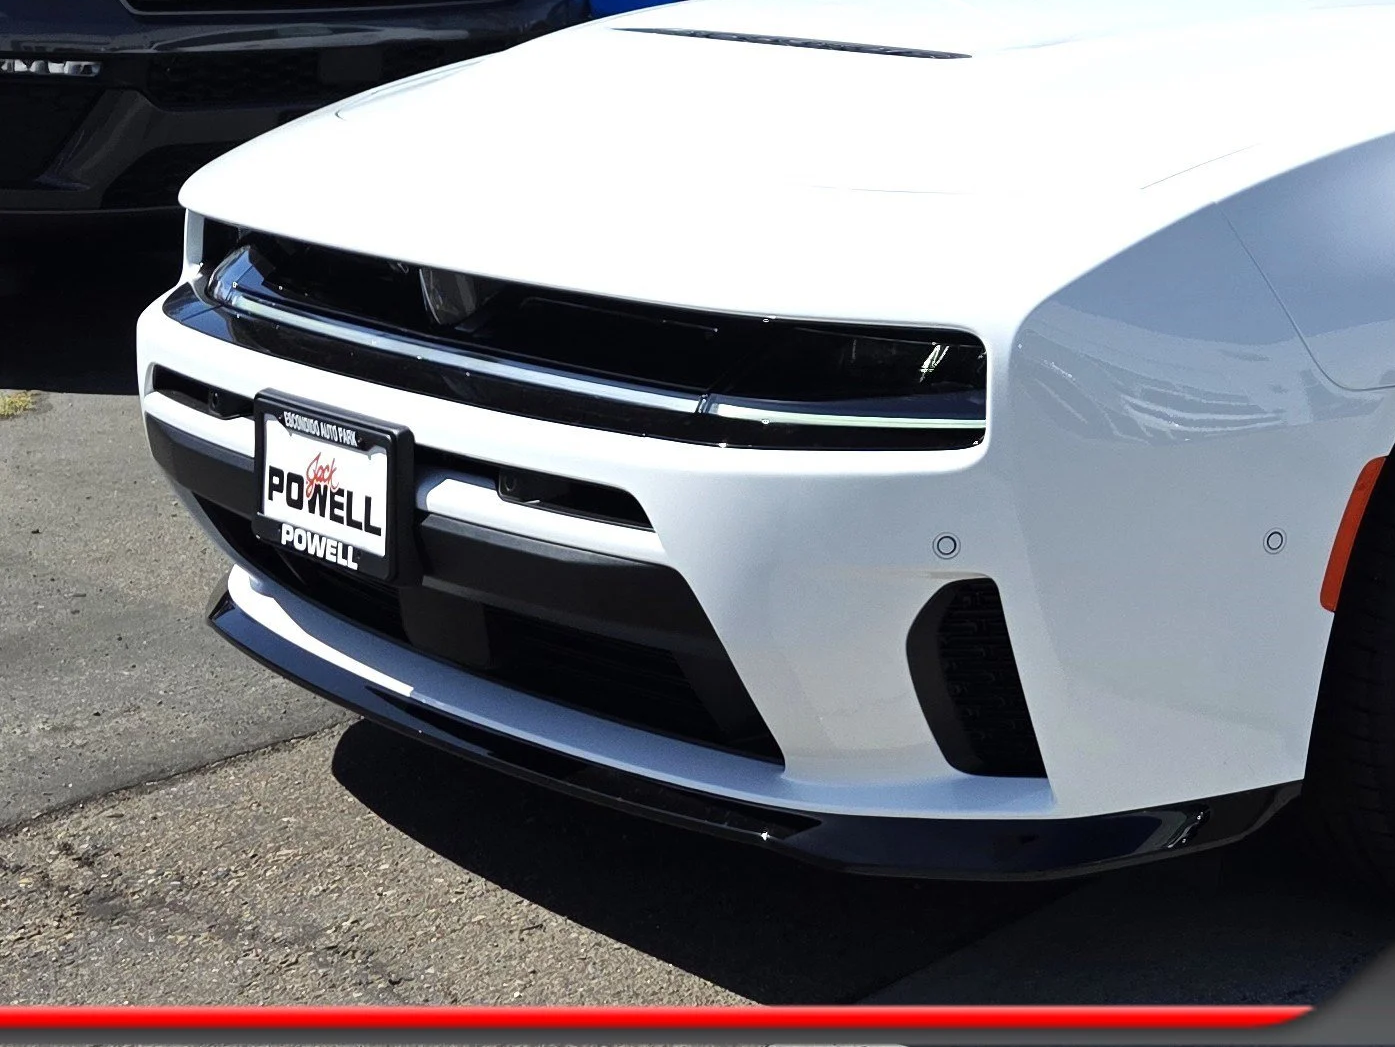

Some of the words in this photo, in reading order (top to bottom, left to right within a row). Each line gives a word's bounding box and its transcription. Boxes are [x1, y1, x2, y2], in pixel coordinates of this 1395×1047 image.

[284, 411, 321, 436] ESCONDIDO
[320, 422, 338, 442] AUTO
[338, 427, 358, 447] PARK
[306, 451, 340, 499] Jack
[268, 465, 382, 537] POWELL
[281, 522, 359, 571] POWELL
